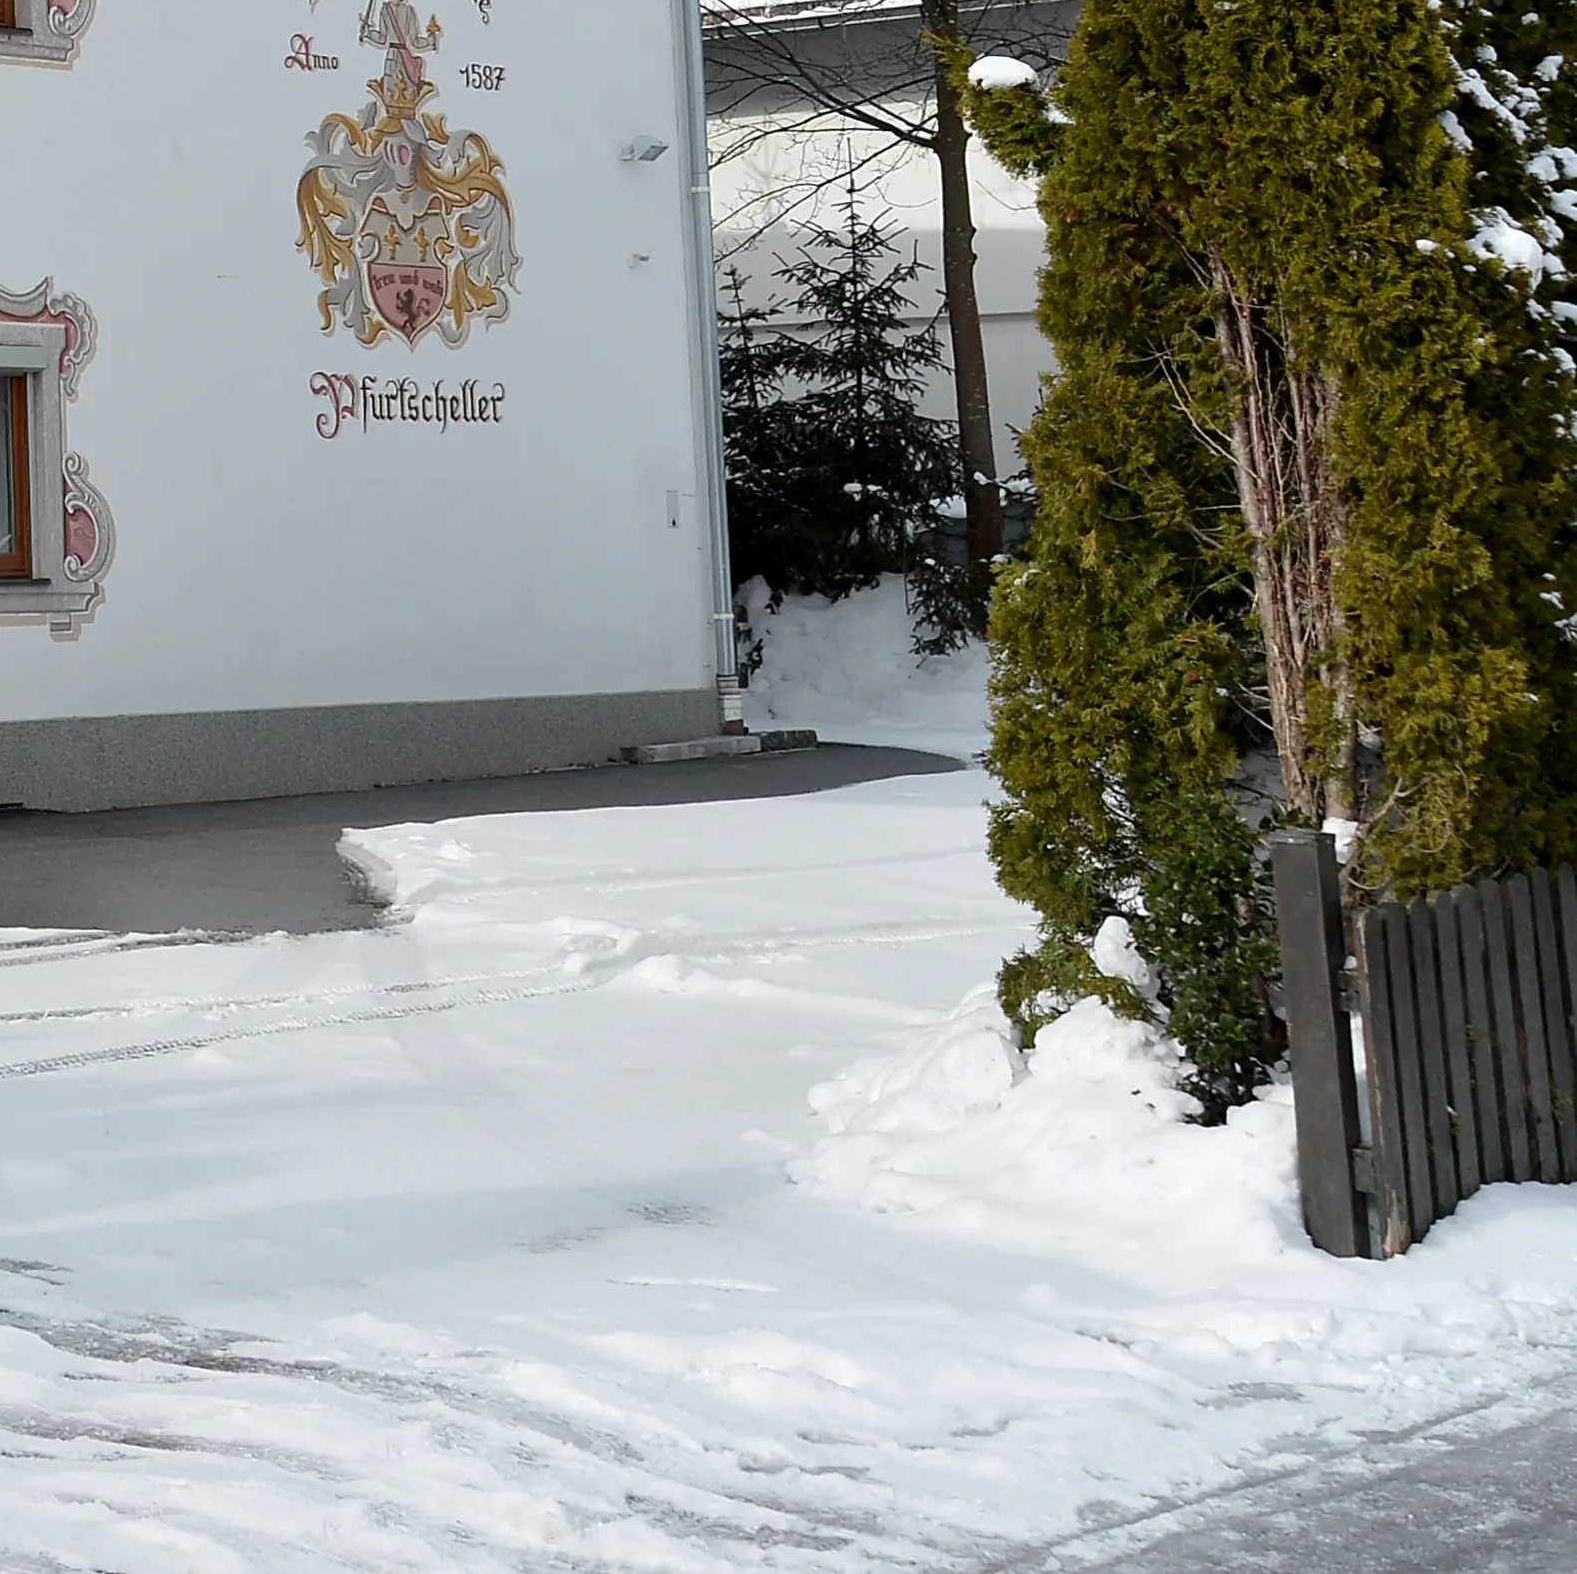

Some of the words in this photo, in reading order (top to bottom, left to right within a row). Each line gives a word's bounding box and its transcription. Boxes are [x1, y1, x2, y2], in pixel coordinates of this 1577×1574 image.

[284, 33, 339, 72] Anno
[459, 64, 506, 91] 1587
[309, 371, 505, 439] Pfurtscheller
